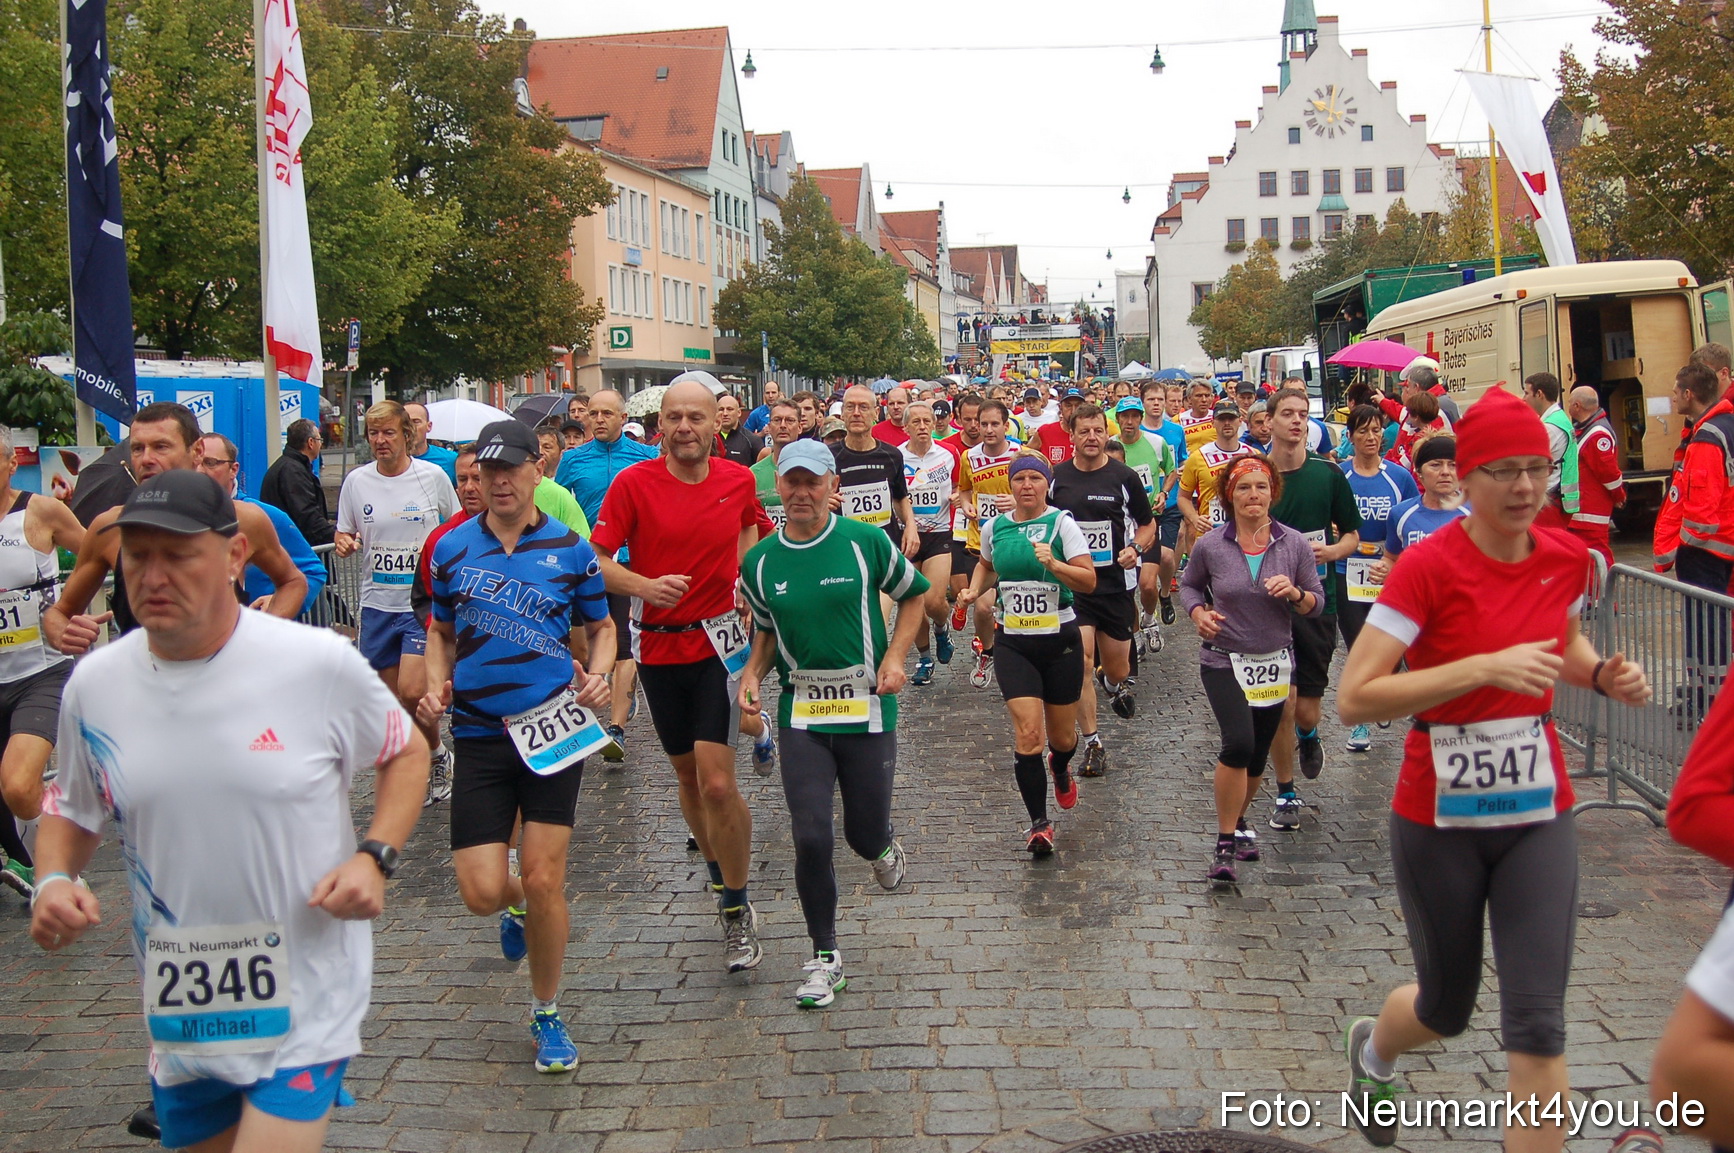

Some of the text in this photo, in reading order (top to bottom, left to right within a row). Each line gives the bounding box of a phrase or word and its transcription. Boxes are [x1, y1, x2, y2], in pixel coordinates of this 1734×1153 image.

[613, 330, 629, 346] D
[1444, 321, 1493, 349] Bayerisches
[1020, 342, 1051, 351] START
[1444, 351, 1467, 370] Rotes
[1442, 374, 1466, 393] Kreuz
[973, 471, 995, 484] MAX
[138, 491, 169, 499] GORE
[851, 494, 883, 513] 263
[981, 504, 997, 517] 28
[1084, 532, 1108, 550] 28
[374, 553, 416, 571] 2644
[384, 575, 405, 583] Achim
[0, 596, 21, 604] markt
[458, 566, 556, 623] TEAM
[1362, 586, 1380, 597] Tanja
[1013, 594, 1048, 614] 305
[1019, 618, 1040, 627] Karin
[0, 635, 15, 645] ritz
[791, 673, 854, 683] PARTL Neumarkt
[1243, 663, 1280, 686] 329
[534, 694, 566, 717] Neumarkt
[810, 704, 850, 716] Stephen
[521, 700, 587, 752] 2615
[249, 743, 285, 752] adidas
[1434, 729, 1527, 748] PARTL Neumarkt
[552, 738, 581, 759] Horst
[1447, 744, 1539, 789] 2547
[149, 936, 259, 954] PARTL Neumarkt
[157, 954, 277, 1008] 2346
[182, 1015, 257, 1039] Michael
